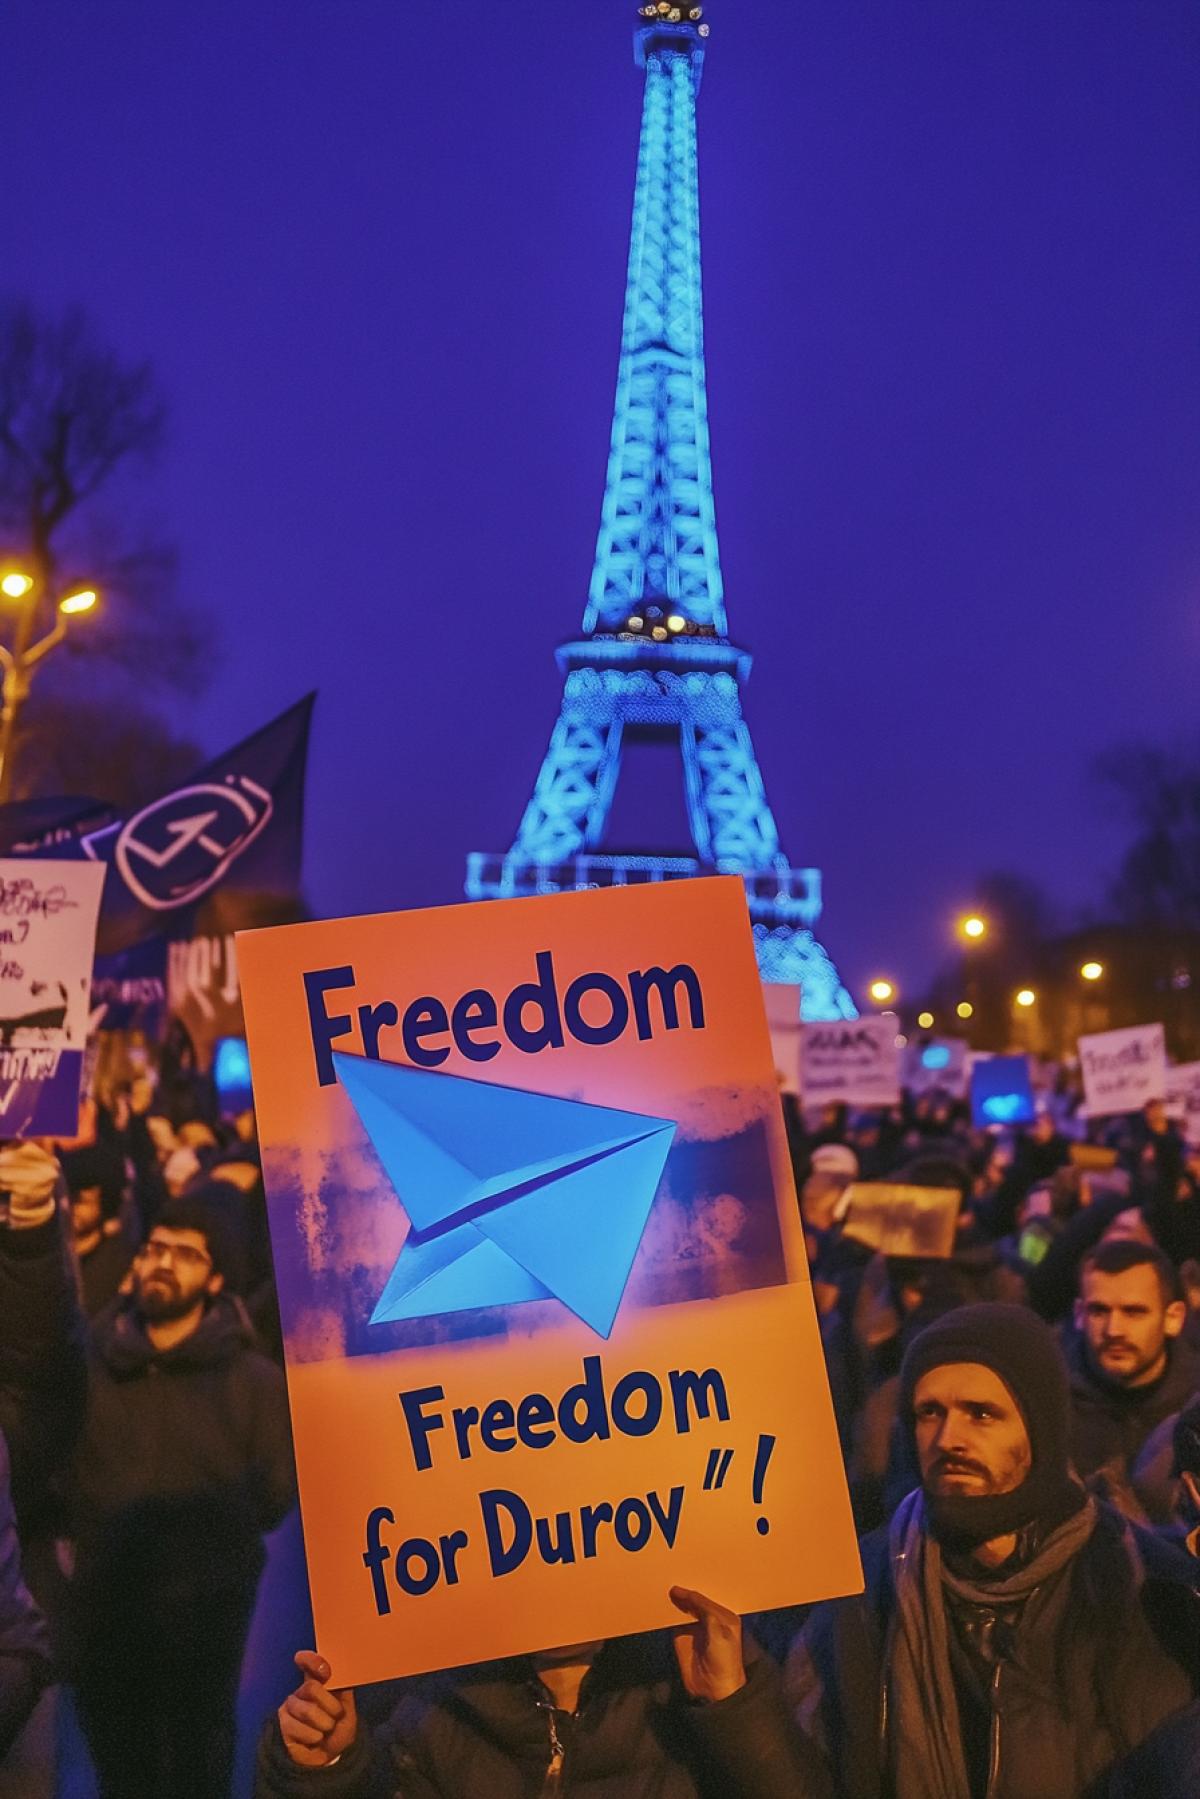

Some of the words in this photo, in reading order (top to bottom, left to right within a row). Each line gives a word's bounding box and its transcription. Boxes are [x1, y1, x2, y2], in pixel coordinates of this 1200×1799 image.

[303, 951, 704, 1086] Freedom
[399, 1356, 730, 1472] Freedom
[363, 1507, 467, 1616] for
